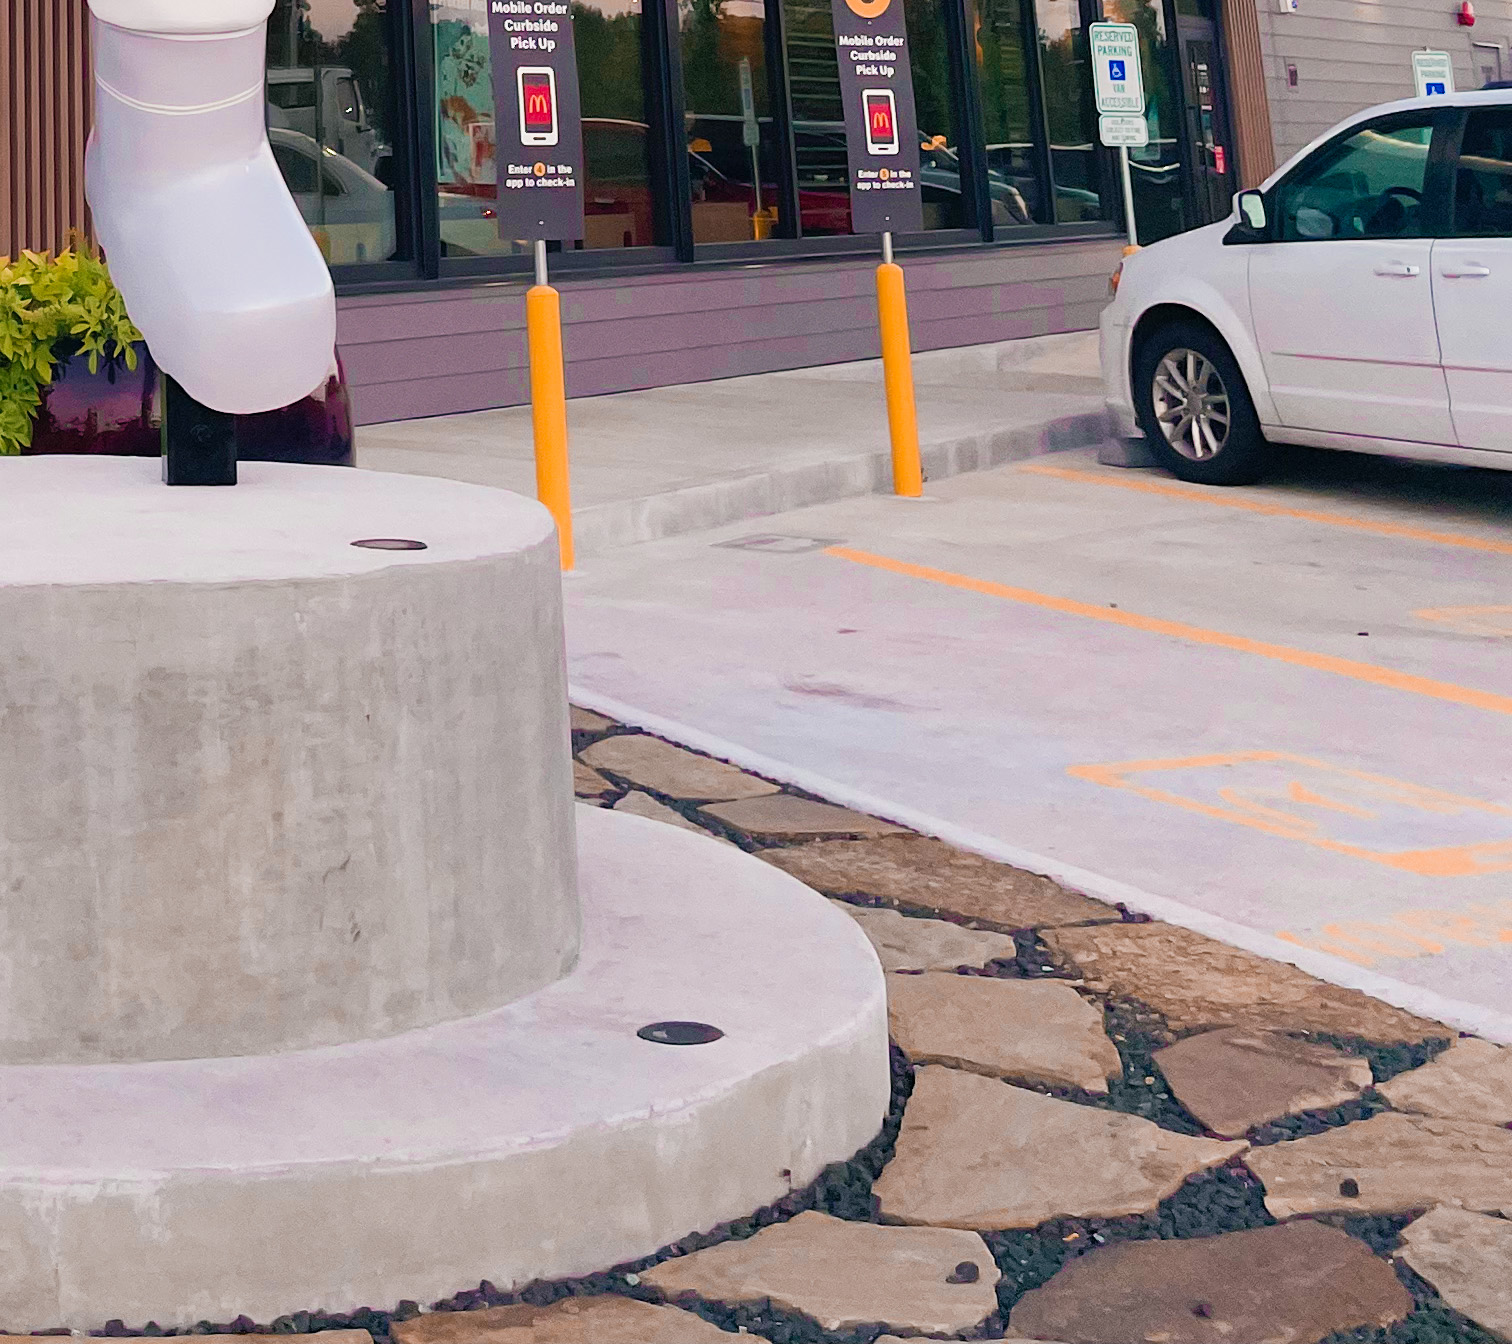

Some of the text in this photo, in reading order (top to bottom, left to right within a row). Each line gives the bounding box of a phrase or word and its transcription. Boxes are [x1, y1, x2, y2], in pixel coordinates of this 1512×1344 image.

[491, 0, 532, 15] Mobile
[533, 1, 568, 15] Order
[504, 18, 559, 33] Curbside
[838, 34, 904, 47] Mobile Order
[1093, 30, 1134, 43] RESERVED
[510, 35, 556, 53] Pick Up
[1097, 44, 1134, 57] PARKING
[849, 49, 897, 62] Curbside
[855, 64, 895, 79] Pick Up
[508, 163, 533, 174] Enter
[547, 164, 556, 174] in
[557, 163, 573, 174] the
[505, 177, 576, 189] app to check-in
